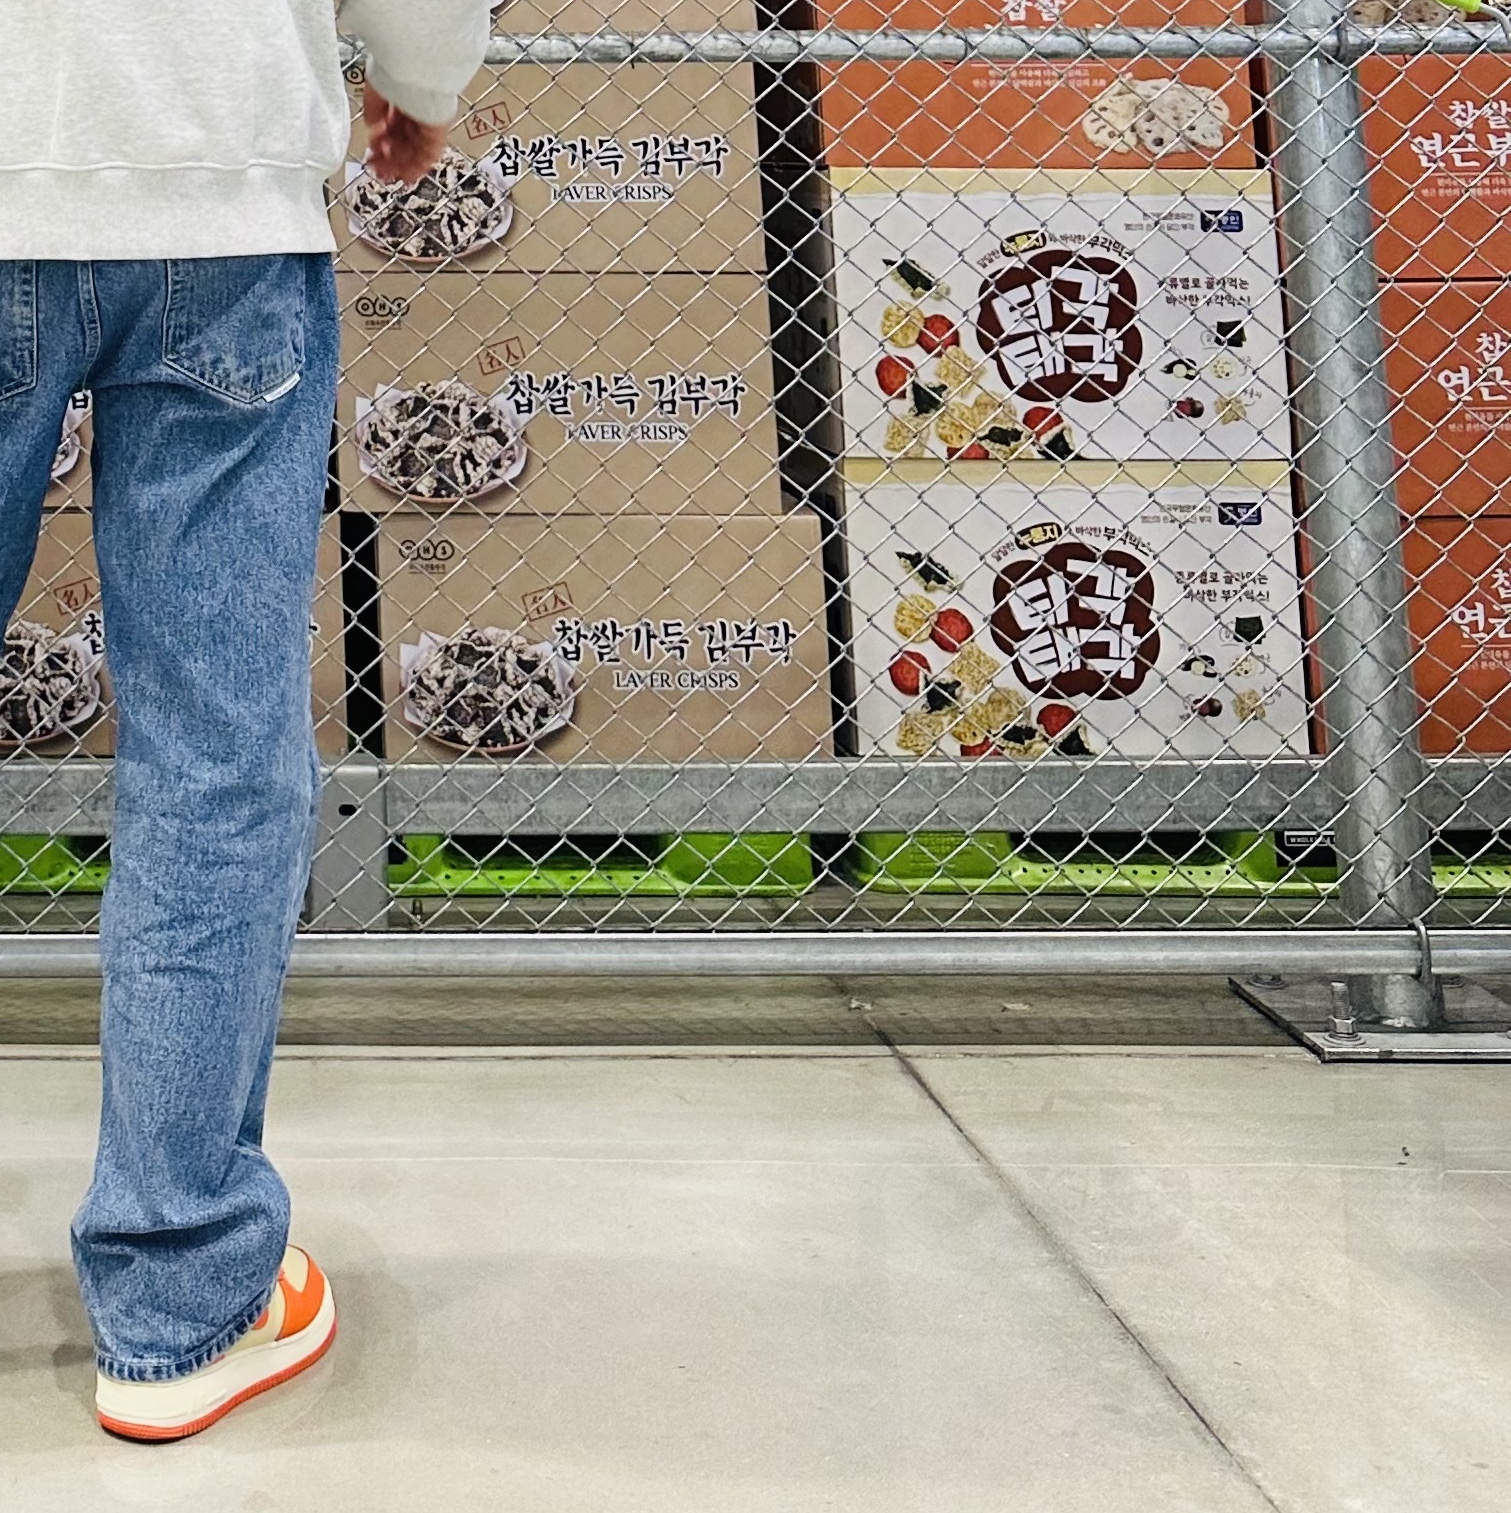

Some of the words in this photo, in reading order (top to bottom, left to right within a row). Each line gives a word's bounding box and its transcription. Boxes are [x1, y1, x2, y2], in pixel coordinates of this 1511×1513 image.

[492, 135, 626, 177] 찹쌀가득
[632, 134, 730, 176] 김부각
[506, 370, 640, 416] 찹쌀가득
[648, 371, 748, 416] 김부각
[553, 618, 690, 663] 찹쌀가득
[698, 618, 797, 663] 김부각
